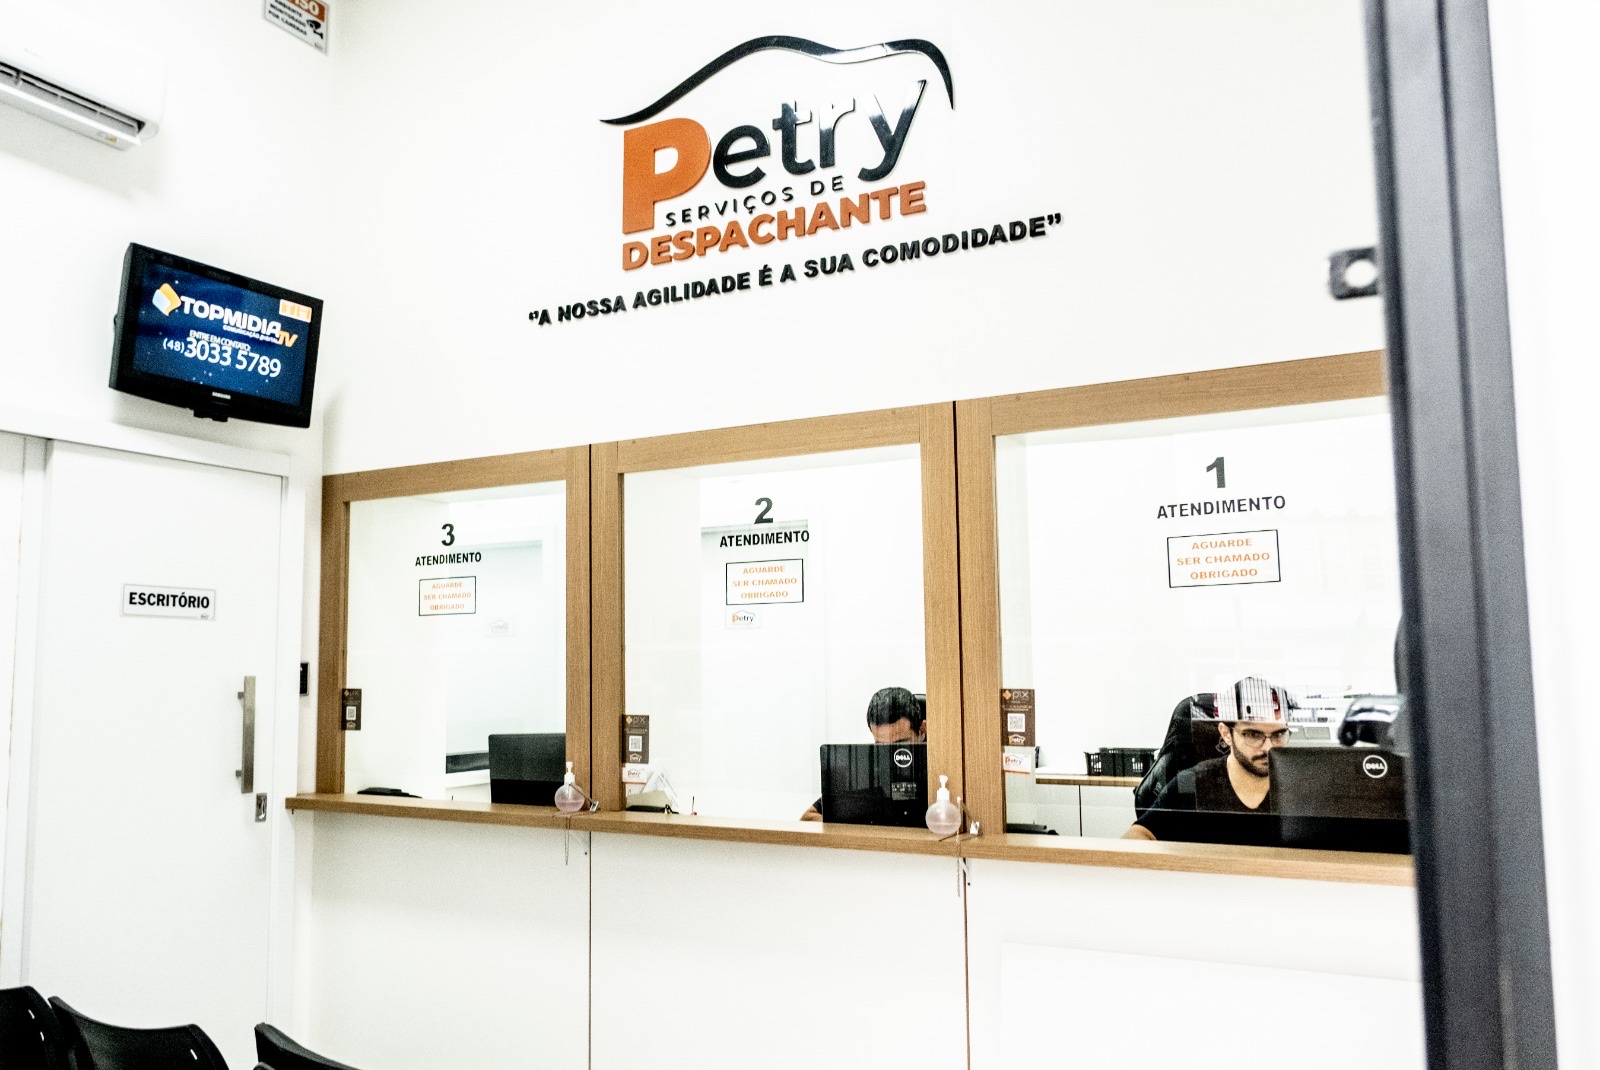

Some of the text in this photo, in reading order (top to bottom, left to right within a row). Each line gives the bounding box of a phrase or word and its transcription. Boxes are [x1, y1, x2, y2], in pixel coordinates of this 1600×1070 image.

[622, 79, 927, 235] Petry
[665, 175, 844, 227] SERVIÇOS DE
[622, 181, 927, 271] DESPACHANTE
[558, 295, 627, 322] NOSSA
[633, 272, 751, 309] AGILIDADE
[759, 265, 773, 287] É
[780, 263, 796, 283] A
[804, 253, 855, 278] SUA
[189, 329, 211, 341] ENTRE
[162, 337, 282, 378] (48) 3033 5789
[1206, 456, 1226, 489] 1
[754, 497, 774, 525] 2
[1157, 495, 1286, 519] ATENDIMENTO
[441, 523, 455, 547] 3
[719, 530, 810, 548] ATENDIMENTO
[1191, 538, 1253, 550] AGUARDE
[415, 551, 482, 567] ATENDIMENTO
[1177, 552, 1270, 566] SER CHAMADO
[742, 565, 785, 575] AGUARDE
[1190, 568, 1258, 580] OBRIGADO
[751, 577, 797, 587] CHAMADO
[128, 591, 210, 609] ESCRITÓRIO
[438, 591, 472, 600] CHAMADO
[741, 590, 789, 600] OBRIGADO
[429, 603, 465, 612] OBRIGADO
